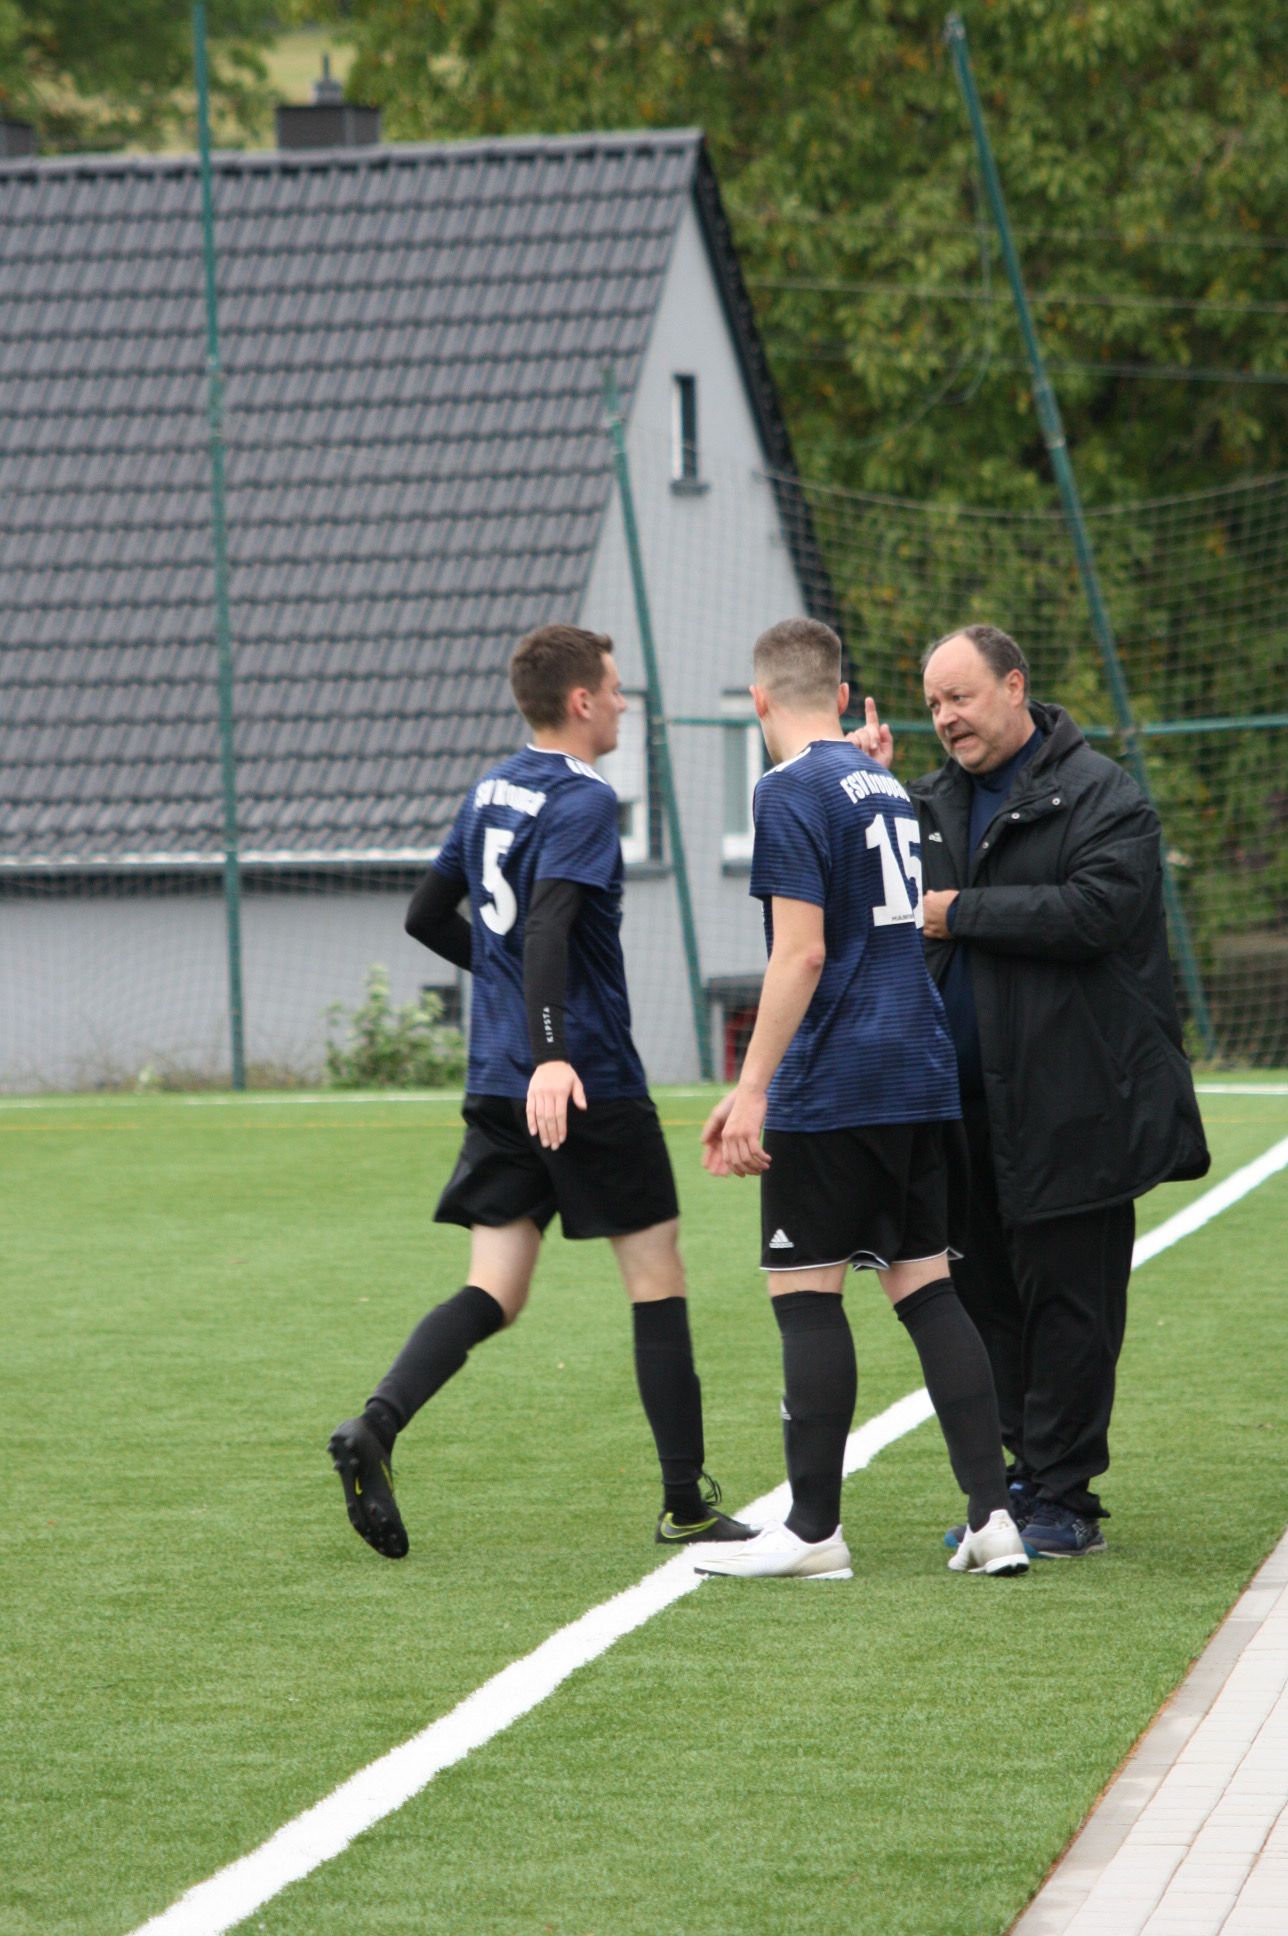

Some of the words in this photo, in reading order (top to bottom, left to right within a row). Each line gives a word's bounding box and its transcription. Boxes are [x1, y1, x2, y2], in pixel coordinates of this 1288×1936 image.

[840, 771, 870, 804] FSV
[479, 828, 517, 936] 5
[865, 814, 924, 929] 15
[542, 1006, 554, 1044] KIPSTA
